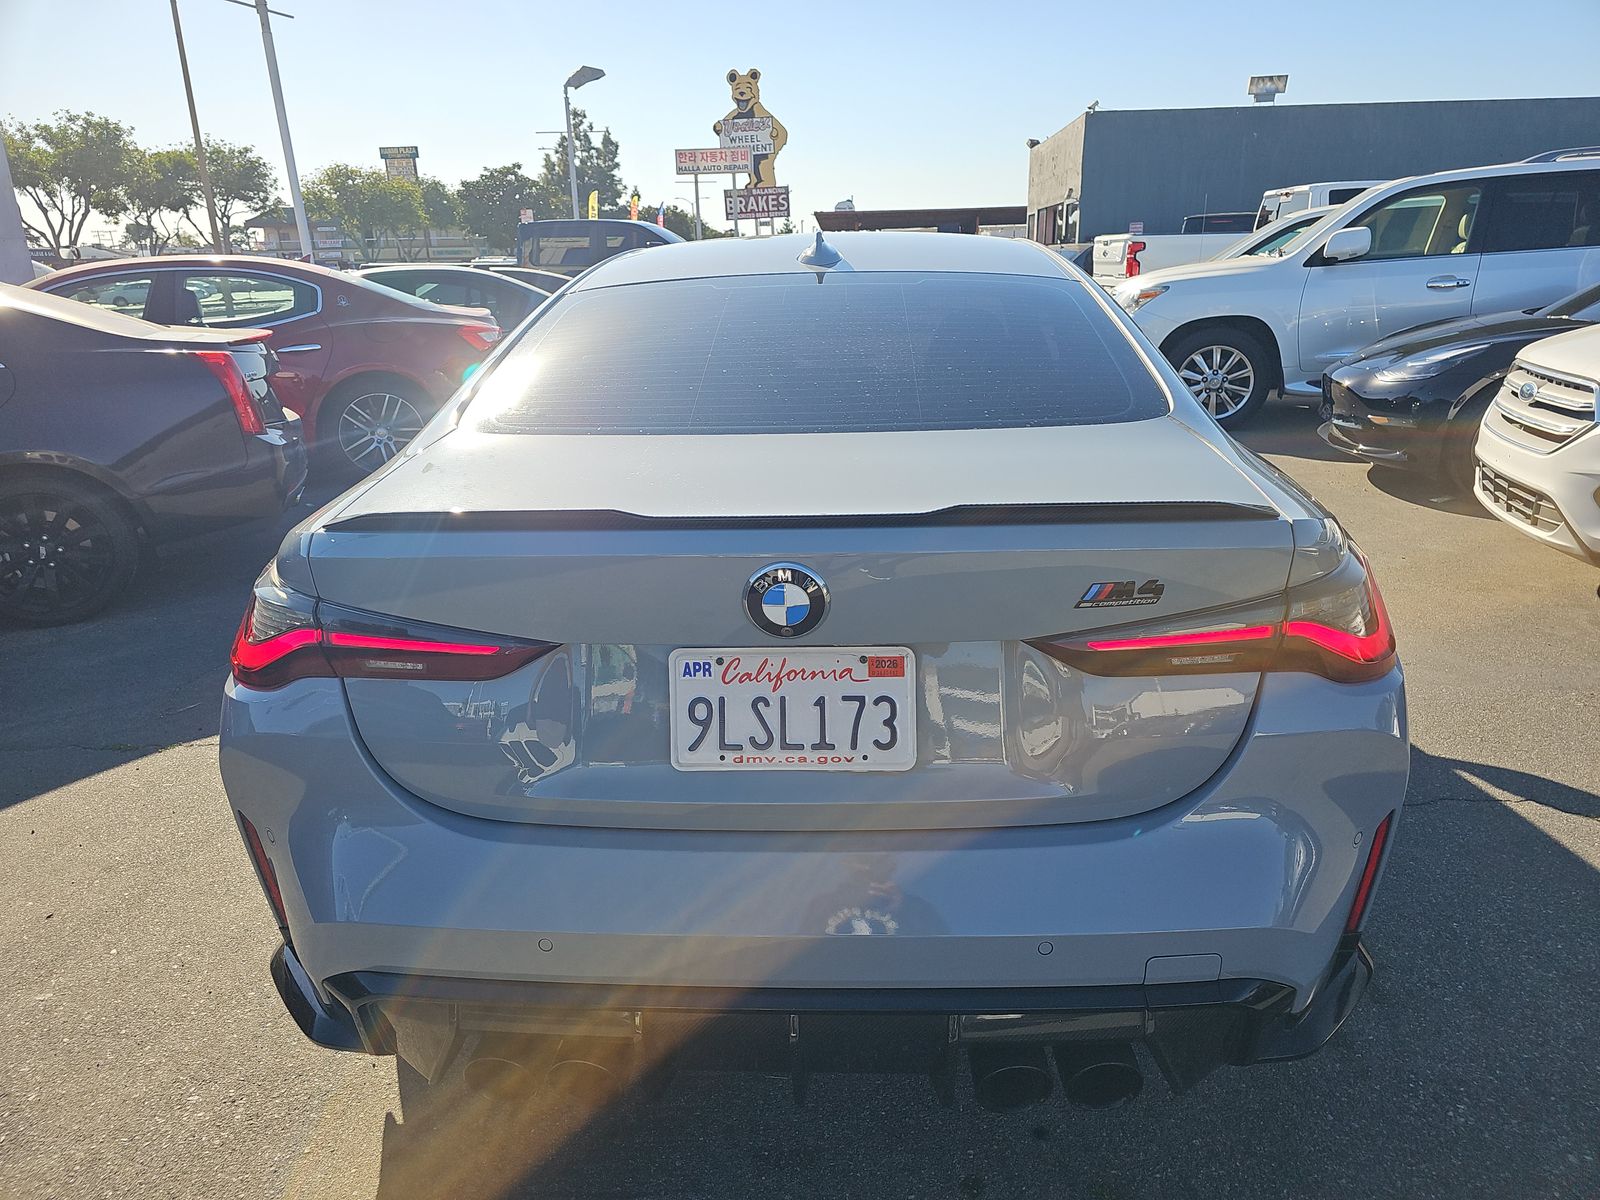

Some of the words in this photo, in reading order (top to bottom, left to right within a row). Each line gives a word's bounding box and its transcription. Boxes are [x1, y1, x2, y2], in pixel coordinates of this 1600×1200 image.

[729, 135, 761, 144] WHEEL
[678, 151, 697, 164] 한라
[700, 150, 727, 163] 자동차
[702, 164, 722, 172] AUTO
[726, 194, 788, 214] BRAKES
[753, 569, 819, 594] BMW
[1100, 579, 1165, 600] M4
[1093, 598, 1157, 607] competition
[682, 661, 712, 678] APR
[875, 659, 898, 669] 2026
[721, 657, 870, 693] California
[687, 695, 899, 752] 9LSL173
[732, 754, 856, 765] dmv.ca.gov
